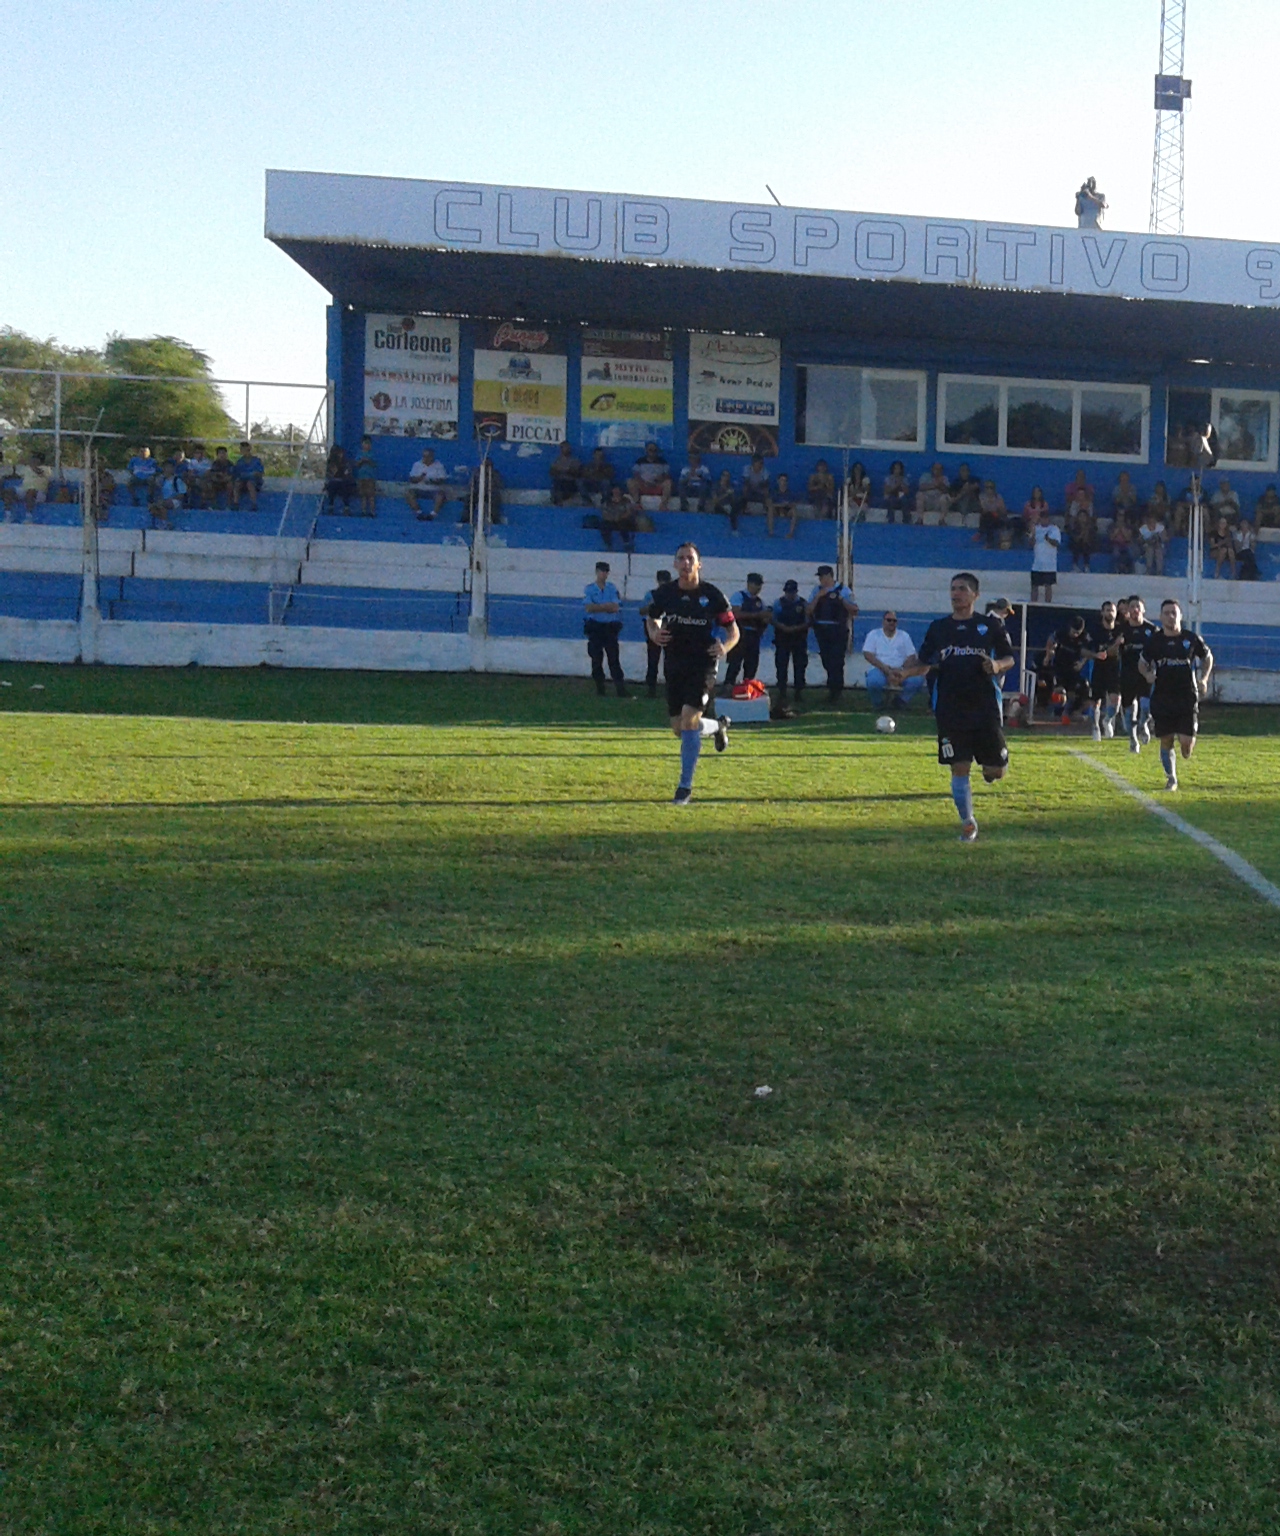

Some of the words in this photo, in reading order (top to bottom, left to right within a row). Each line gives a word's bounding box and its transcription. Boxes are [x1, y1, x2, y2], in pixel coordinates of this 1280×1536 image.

[433, 188, 671, 256] CLUB
[729, 209, 1191, 293] SPORTIVO
[374, 329, 452, 353] Corleone
[394, 395, 408, 410] LA
[411, 396, 453, 411] JOSEFINA
[512, 424, 562, 442] PICCAT
[677, 615, 708, 626] Trabuco
[953, 645, 986, 656] Trabuco
